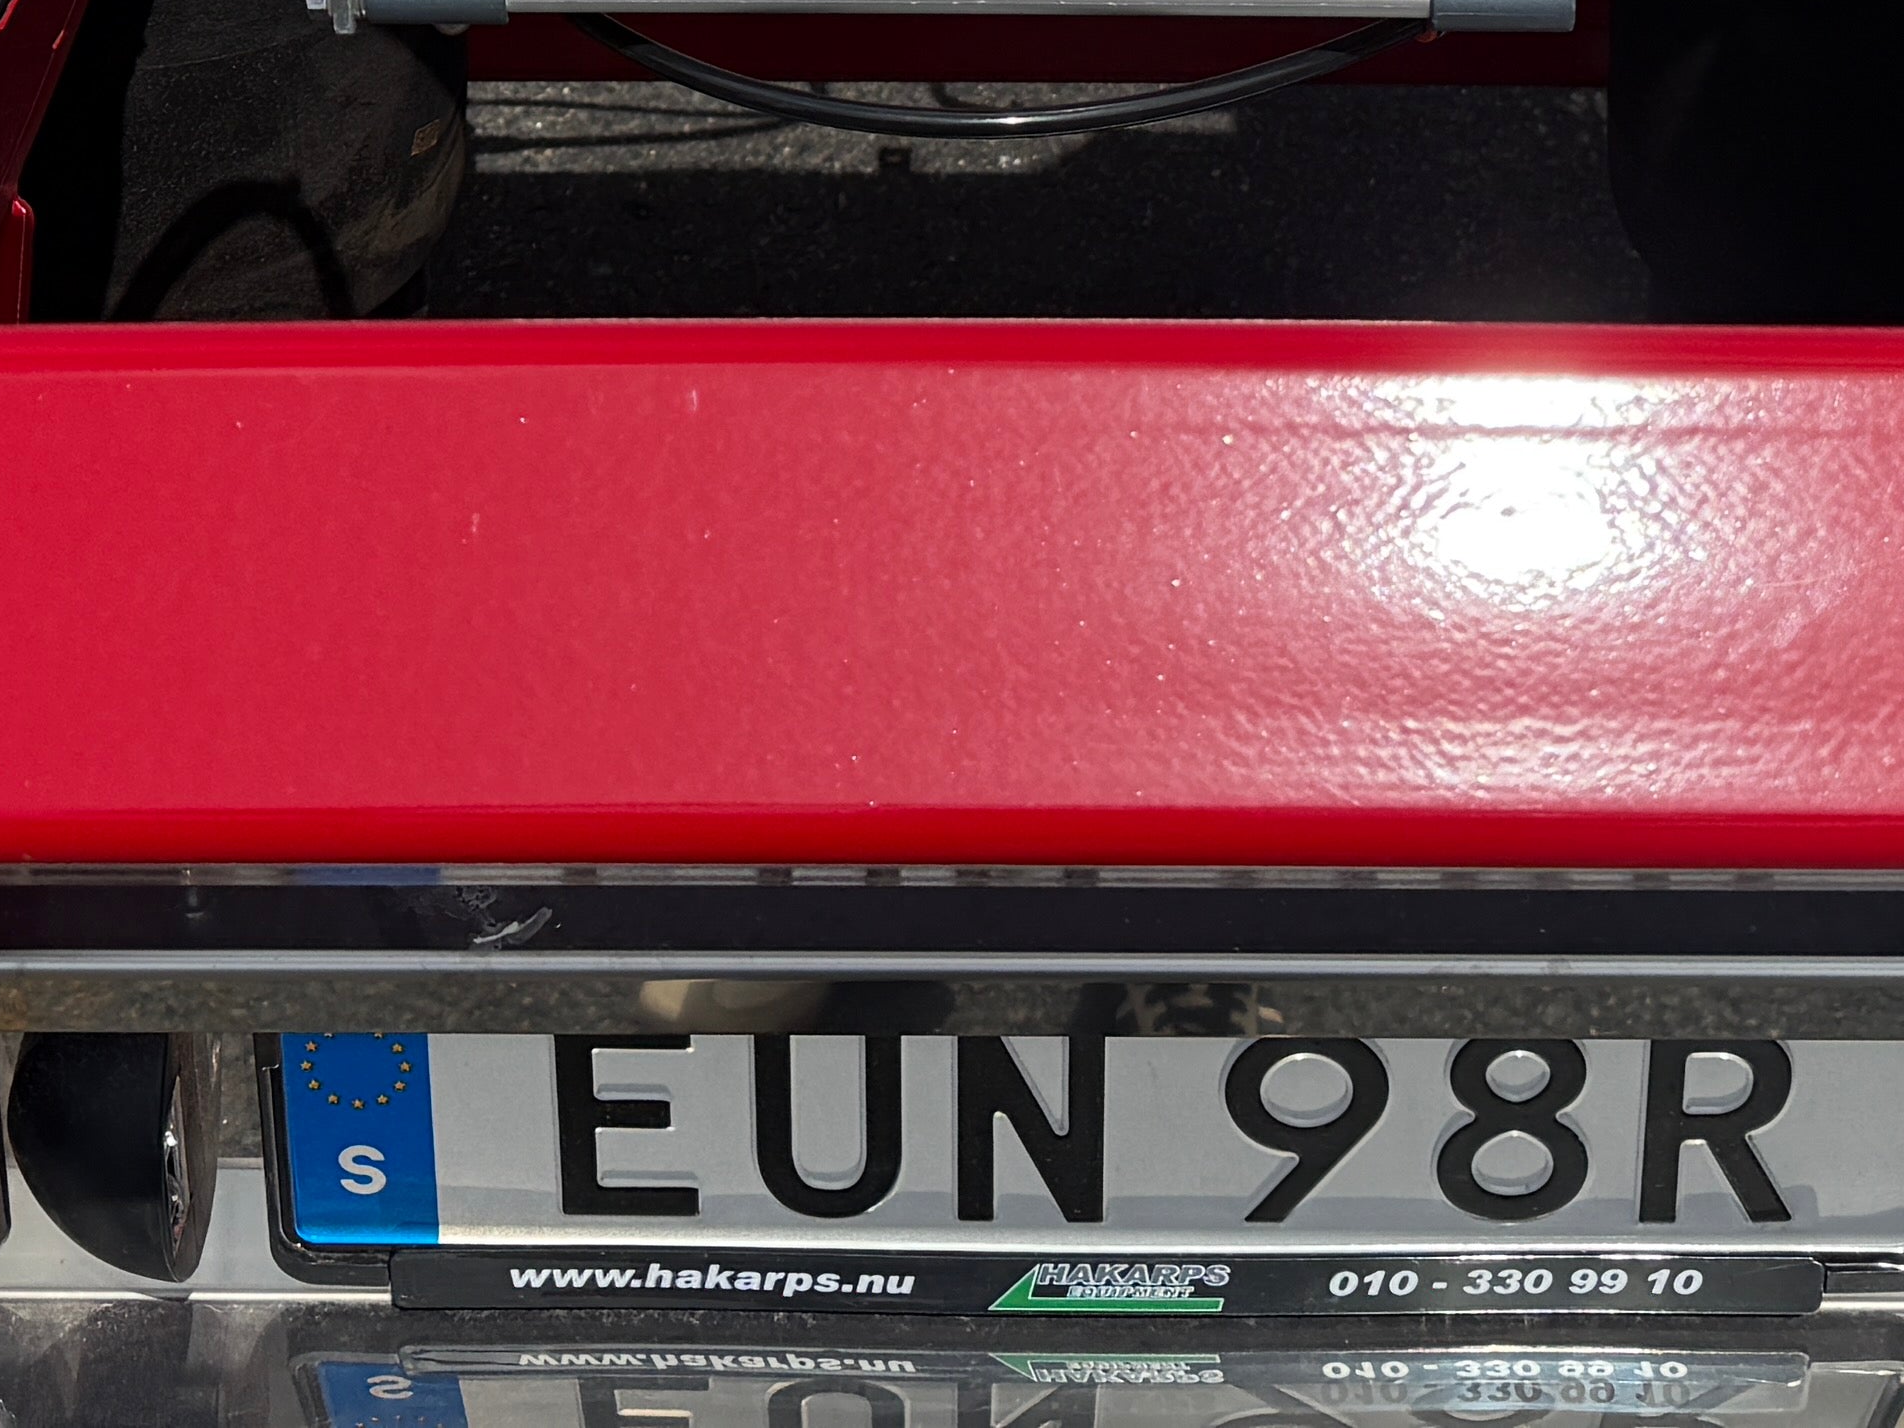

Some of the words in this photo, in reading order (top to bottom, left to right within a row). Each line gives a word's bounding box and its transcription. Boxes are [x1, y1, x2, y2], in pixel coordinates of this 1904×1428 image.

[555, 1035, 1106, 1224] EUN
[1224, 1036, 1794, 1224] 98R
[337, 1143, 388, 1196] S
[509, 1262, 917, 1297] www.hakarps.nu
[1036, 1262, 1232, 1286] HAKARPS
[1328, 1269, 1420, 1297] 010
[1462, 1268, 1554, 1295] 330
[1568, 1268, 1629, 1295] 99
[1646, 1268, 1704, 1295] 10
[1066, 1285, 1195, 1299] EQUIPMENT
